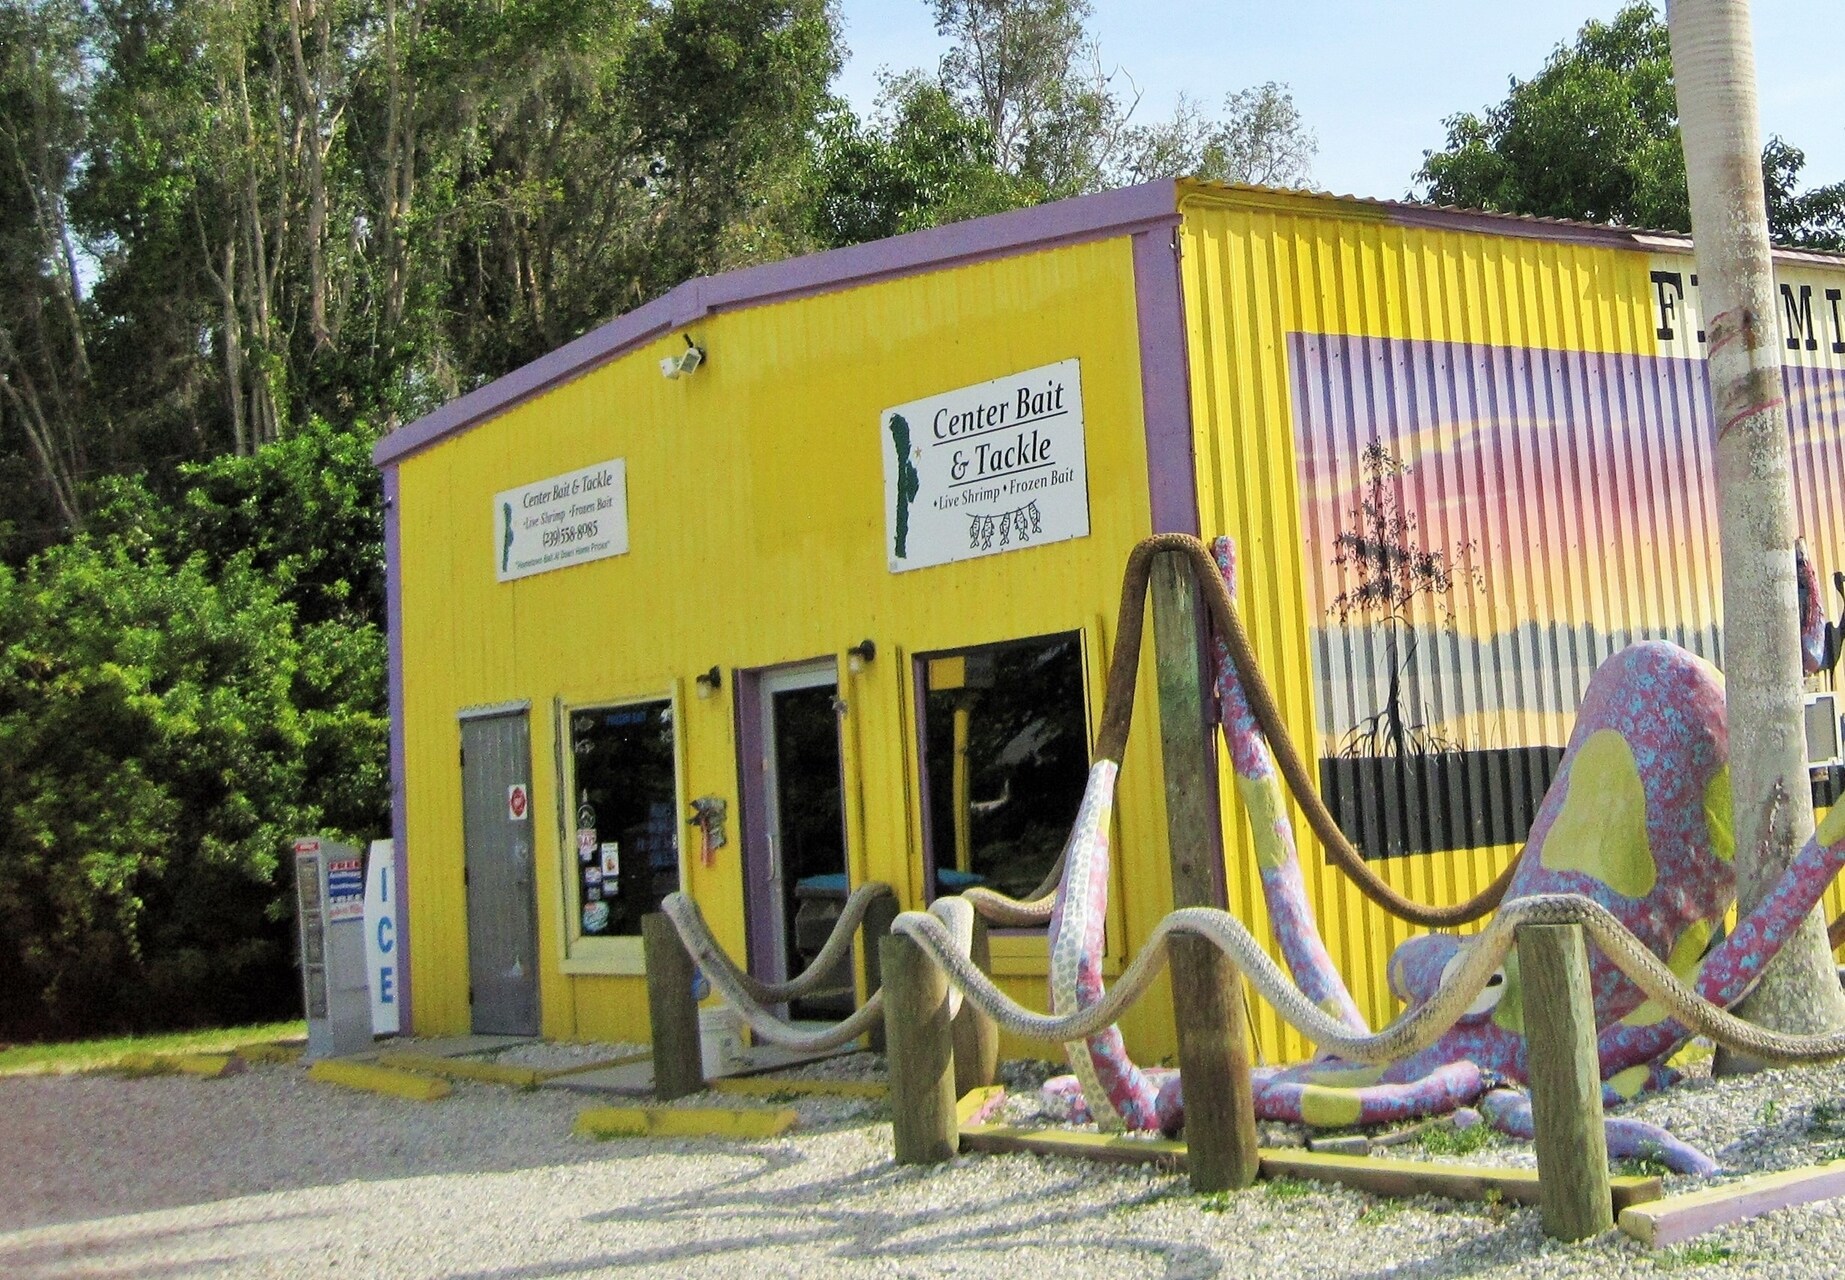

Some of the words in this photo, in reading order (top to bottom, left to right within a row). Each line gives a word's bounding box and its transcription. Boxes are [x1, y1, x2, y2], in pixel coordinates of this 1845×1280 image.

[934, 401, 1009, 439] Center
[1016, 380, 1064, 420] Bait
[951, 450, 969, 481] &
[975, 430, 1051, 475] Tackle
[523, 492, 550, 509] Center
[552, 482, 570, 503] Bait
[571, 478, 581, 496] &
[582, 469, 613, 493] Tackle
[541, 509, 565, 525] Shrimp
[570, 503, 595, 518] Frozen
[597, 495, 613, 511] Bait
[939, 494, 959, 510] Live
[962, 487, 1000, 504] Shrimp
[1009, 475, 1047, 494] Frozen
[1051, 467, 1074, 486] Bait
[377, 867, 394, 1004] ICE
